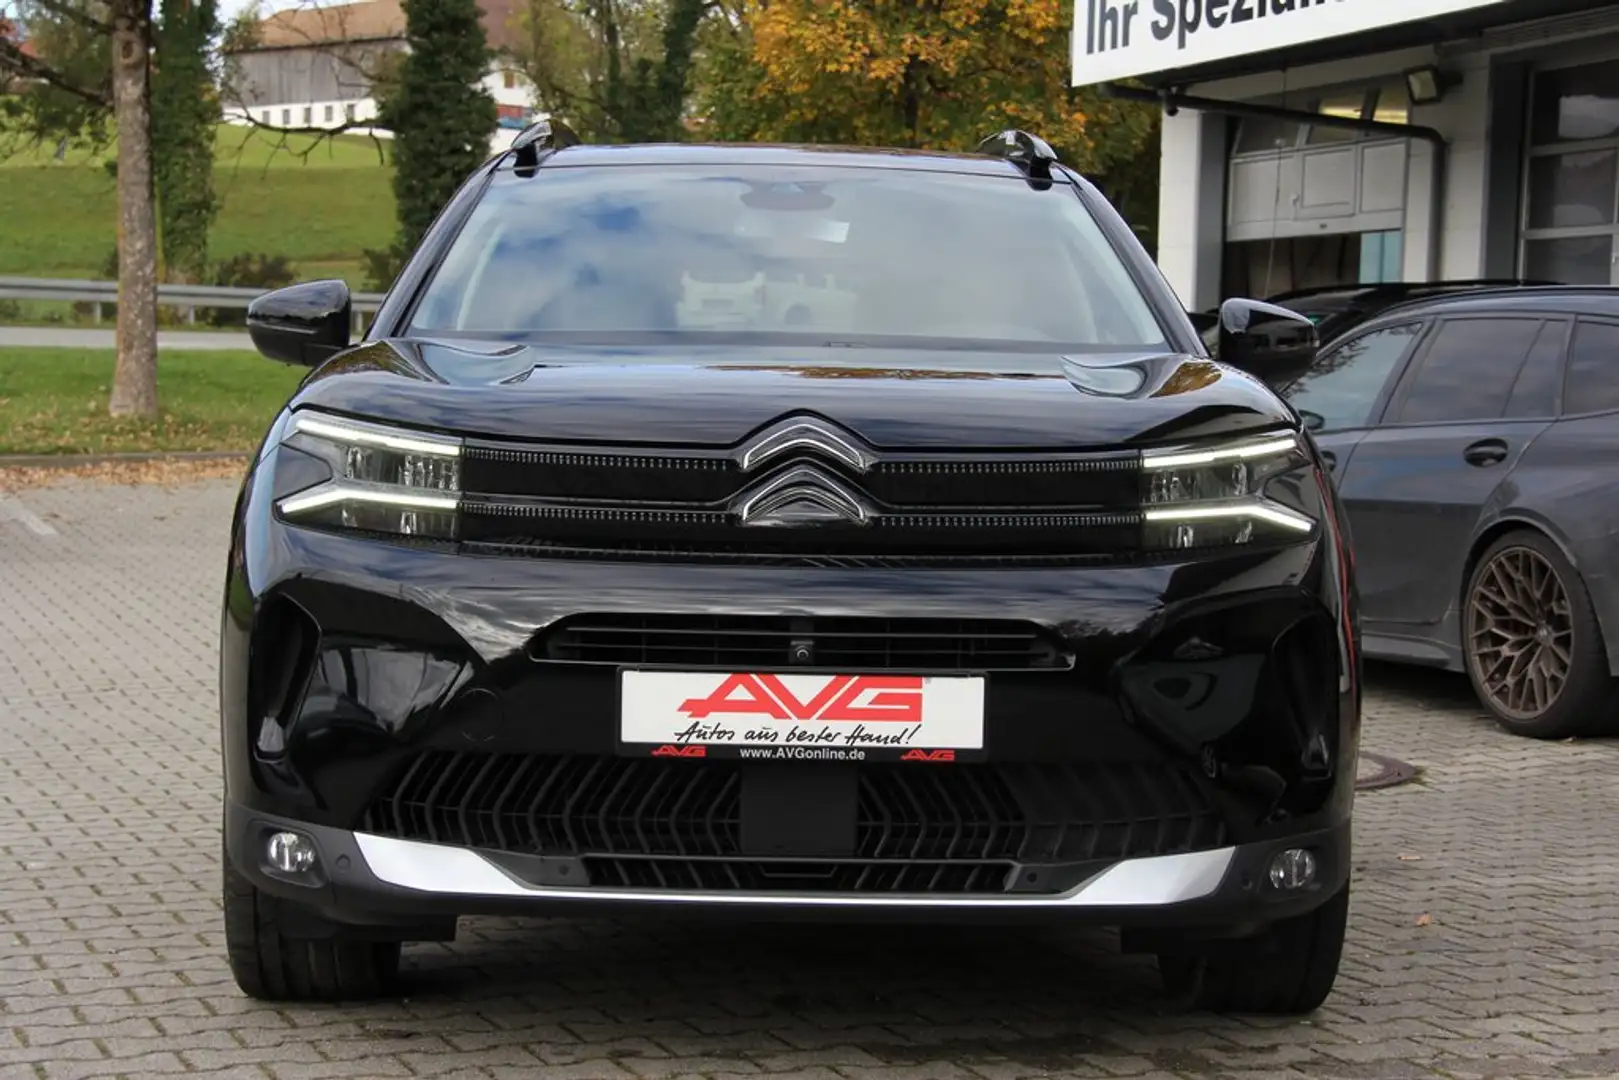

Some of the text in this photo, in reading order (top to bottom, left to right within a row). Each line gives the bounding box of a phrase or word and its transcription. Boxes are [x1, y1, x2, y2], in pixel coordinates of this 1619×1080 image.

[1086, 0, 1138, 54] Ihr
[677, 672, 922, 722] AVG
[674, 721, 922, 746] Autos aus bester Hand!
[651, 744, 955, 761] AVG www.AVGonline.de AVG
